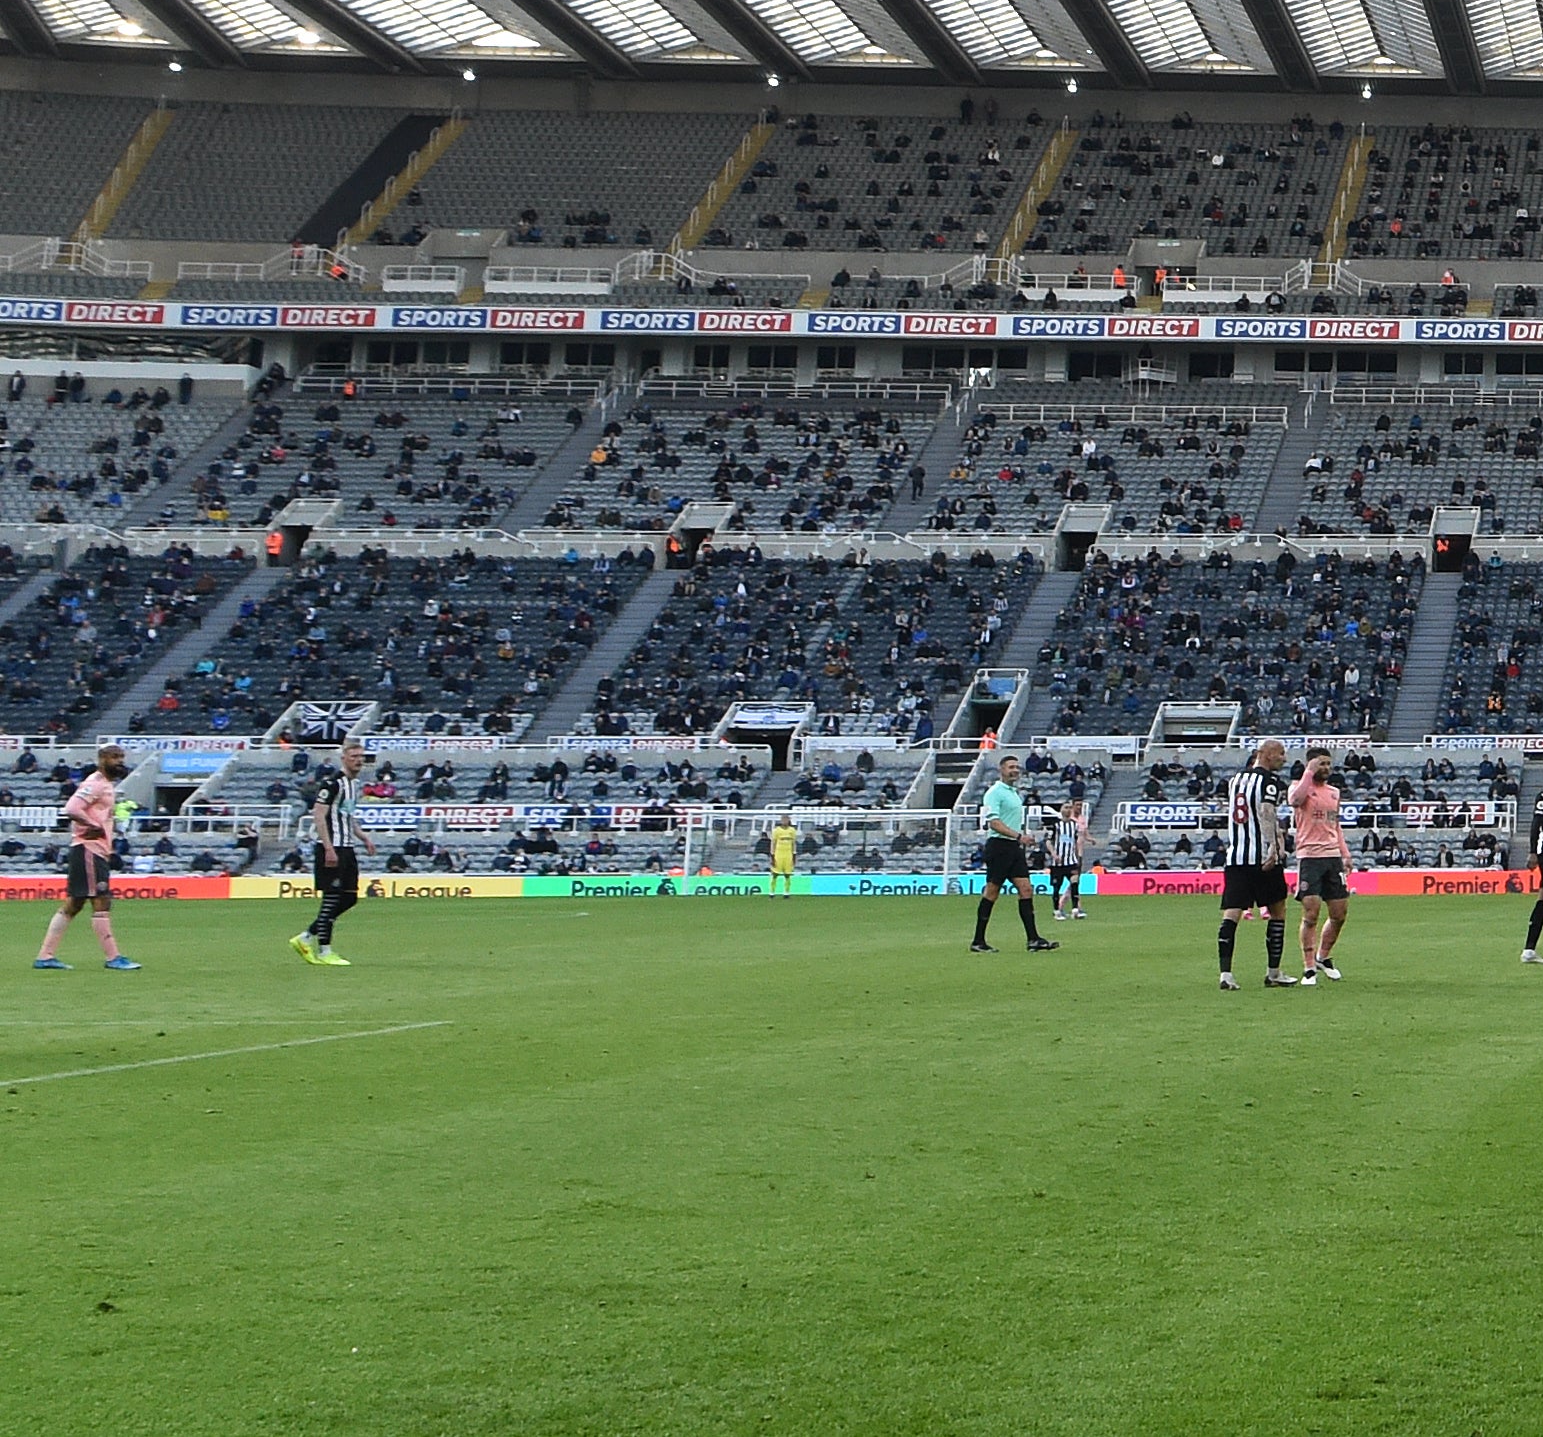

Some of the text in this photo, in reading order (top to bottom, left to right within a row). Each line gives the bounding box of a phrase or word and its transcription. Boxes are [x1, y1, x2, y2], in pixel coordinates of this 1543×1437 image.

[71, 304, 160, 323] DIRECT
[186, 307, 371, 326] SPORTS DIRECT
[399, 309, 579, 329] SPORTS DIRECT
[606, 312, 786, 331] SPORTS DIRECT
[813, 314, 994, 334] SPORTS DIRECT
[1018, 318, 1194, 336] SPORTS DIRECT
[1221, 320, 1394, 339] SPORTS DIRECT
[1416, 322, 1500, 339] SPORTS
[1435, 736, 1496, 749] SPORTS
[430, 806, 511, 824] DIRECT
[1134, 806, 1198, 822] SPORT
[1232, 792, 1249, 825] 8
[392, 881, 473, 898] League
[571, 880, 651, 896] Premier
[859, 880, 938, 895] Premier
[1142, 877, 1221, 894] Premier
[1422, 875, 1500, 894] Premier
